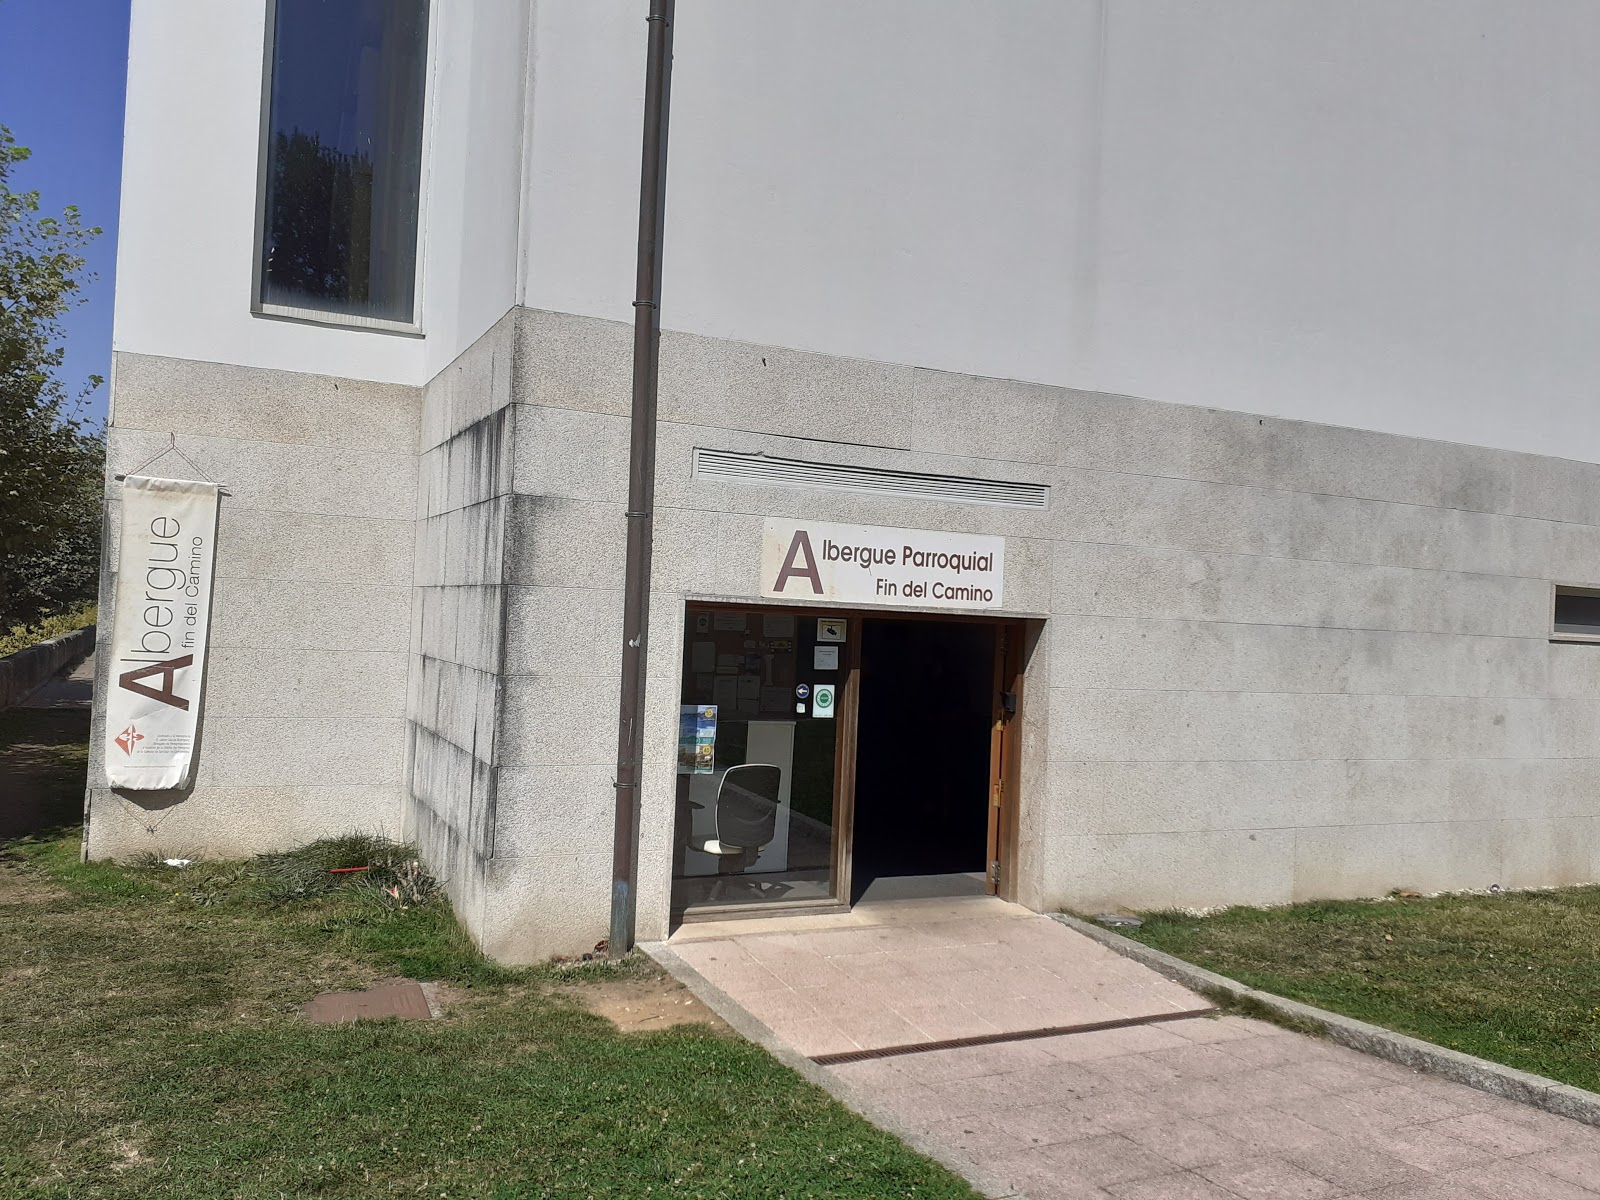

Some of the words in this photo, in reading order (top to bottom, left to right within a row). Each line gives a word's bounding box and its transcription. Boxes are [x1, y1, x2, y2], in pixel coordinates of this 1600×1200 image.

[185, 536, 203, 597] Camino
[773, 530, 897, 594] Albergue
[902, 546, 993, 574] Parroquial
[876, 578, 897, 596] Fin
[902, 581, 927, 598] del
[932, 582, 993, 602] Camino
[119, 516, 193, 711] Albergue
[184, 603, 197, 626] del
[181, 631, 195, 648] fin
